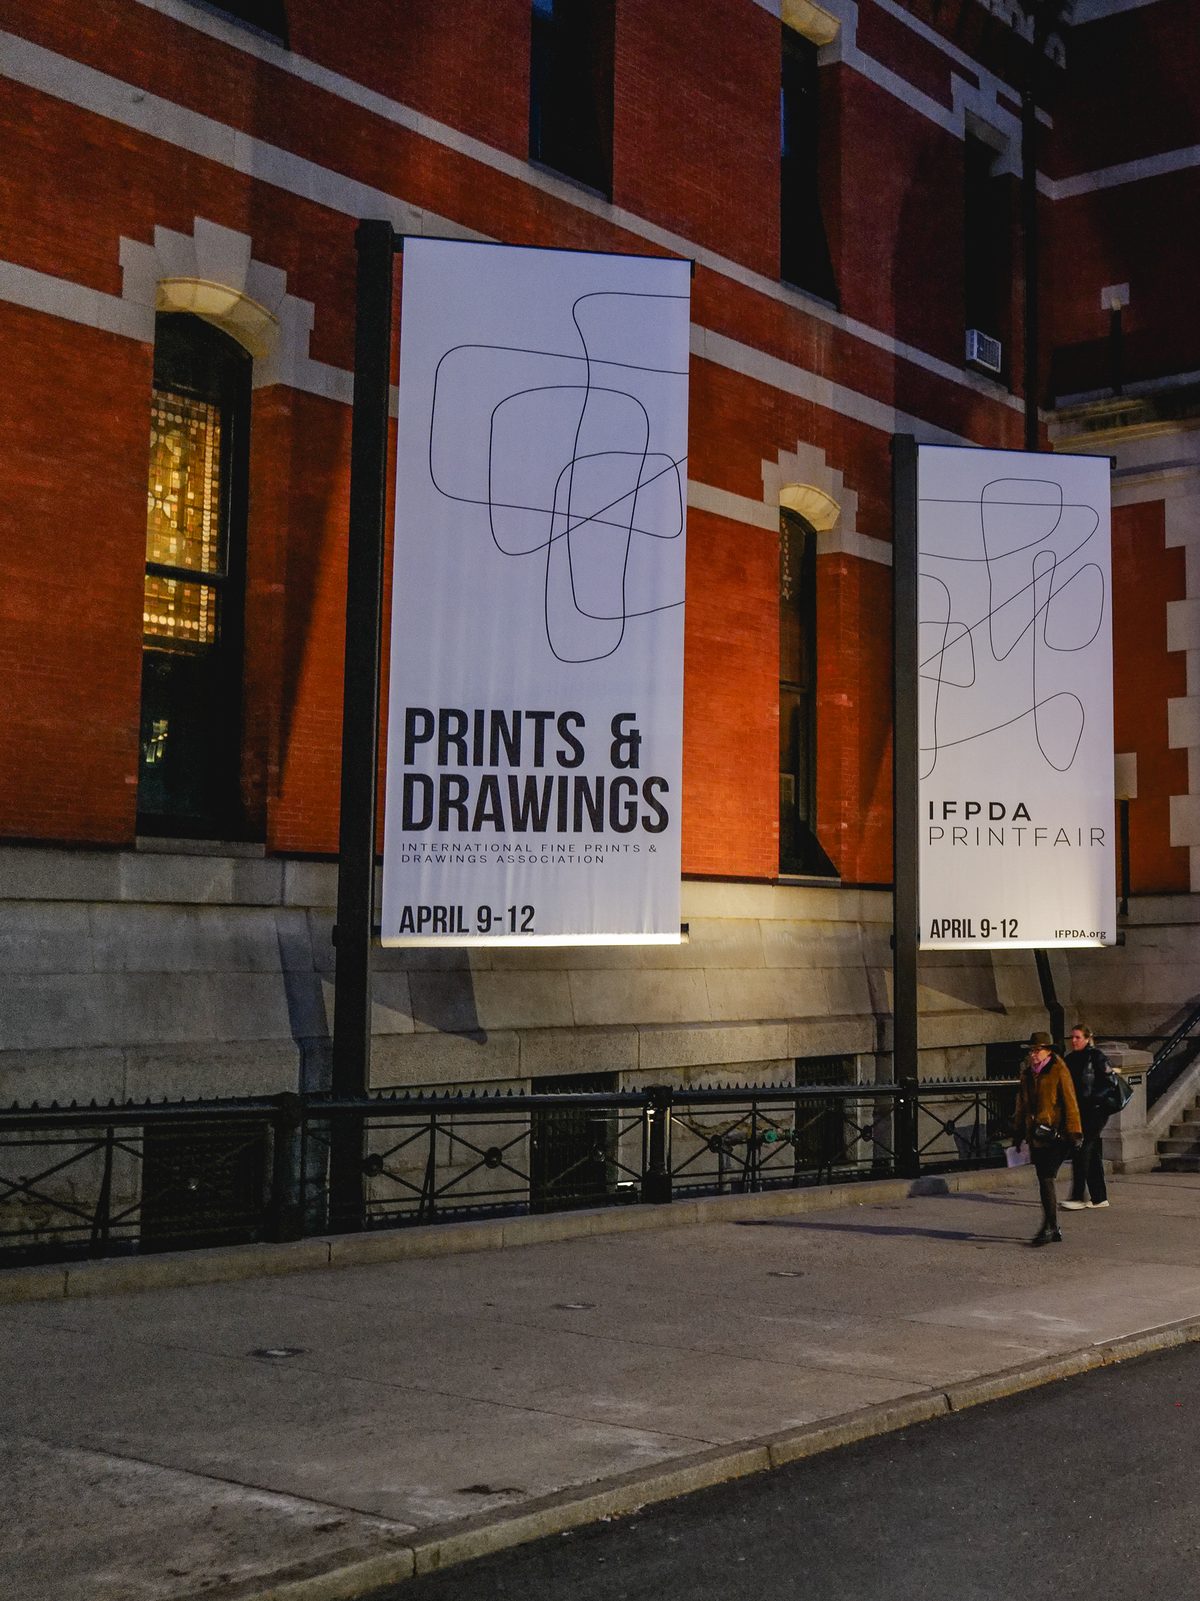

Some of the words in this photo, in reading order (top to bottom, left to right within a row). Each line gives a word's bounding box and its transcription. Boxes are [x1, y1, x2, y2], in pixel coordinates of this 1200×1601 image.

[403, 707, 586, 769] PRINTS
[609, 712, 643, 770] &
[401, 772, 670, 834] DRAWINGS
[929, 801, 1032, 822] IFPDA
[929, 826, 1106, 847] PRINTFAIR
[401, 842, 533, 853] INTERNATIONAL
[541, 843, 577, 853] FINE
[584, 844, 641, 853] PRINTS
[648, 844, 658, 853] &
[401, 854, 488, 864] DRAWINGS
[496, 855, 605, 864] ASSOCIATION
[399, 905, 470, 934] APRIL
[476, 904, 536, 934] 9-12
[930, 918, 977, 939] APRIL
[980, 918, 1019, 939] 9-12
[1054, 929, 1107, 940] IFPDA.org
